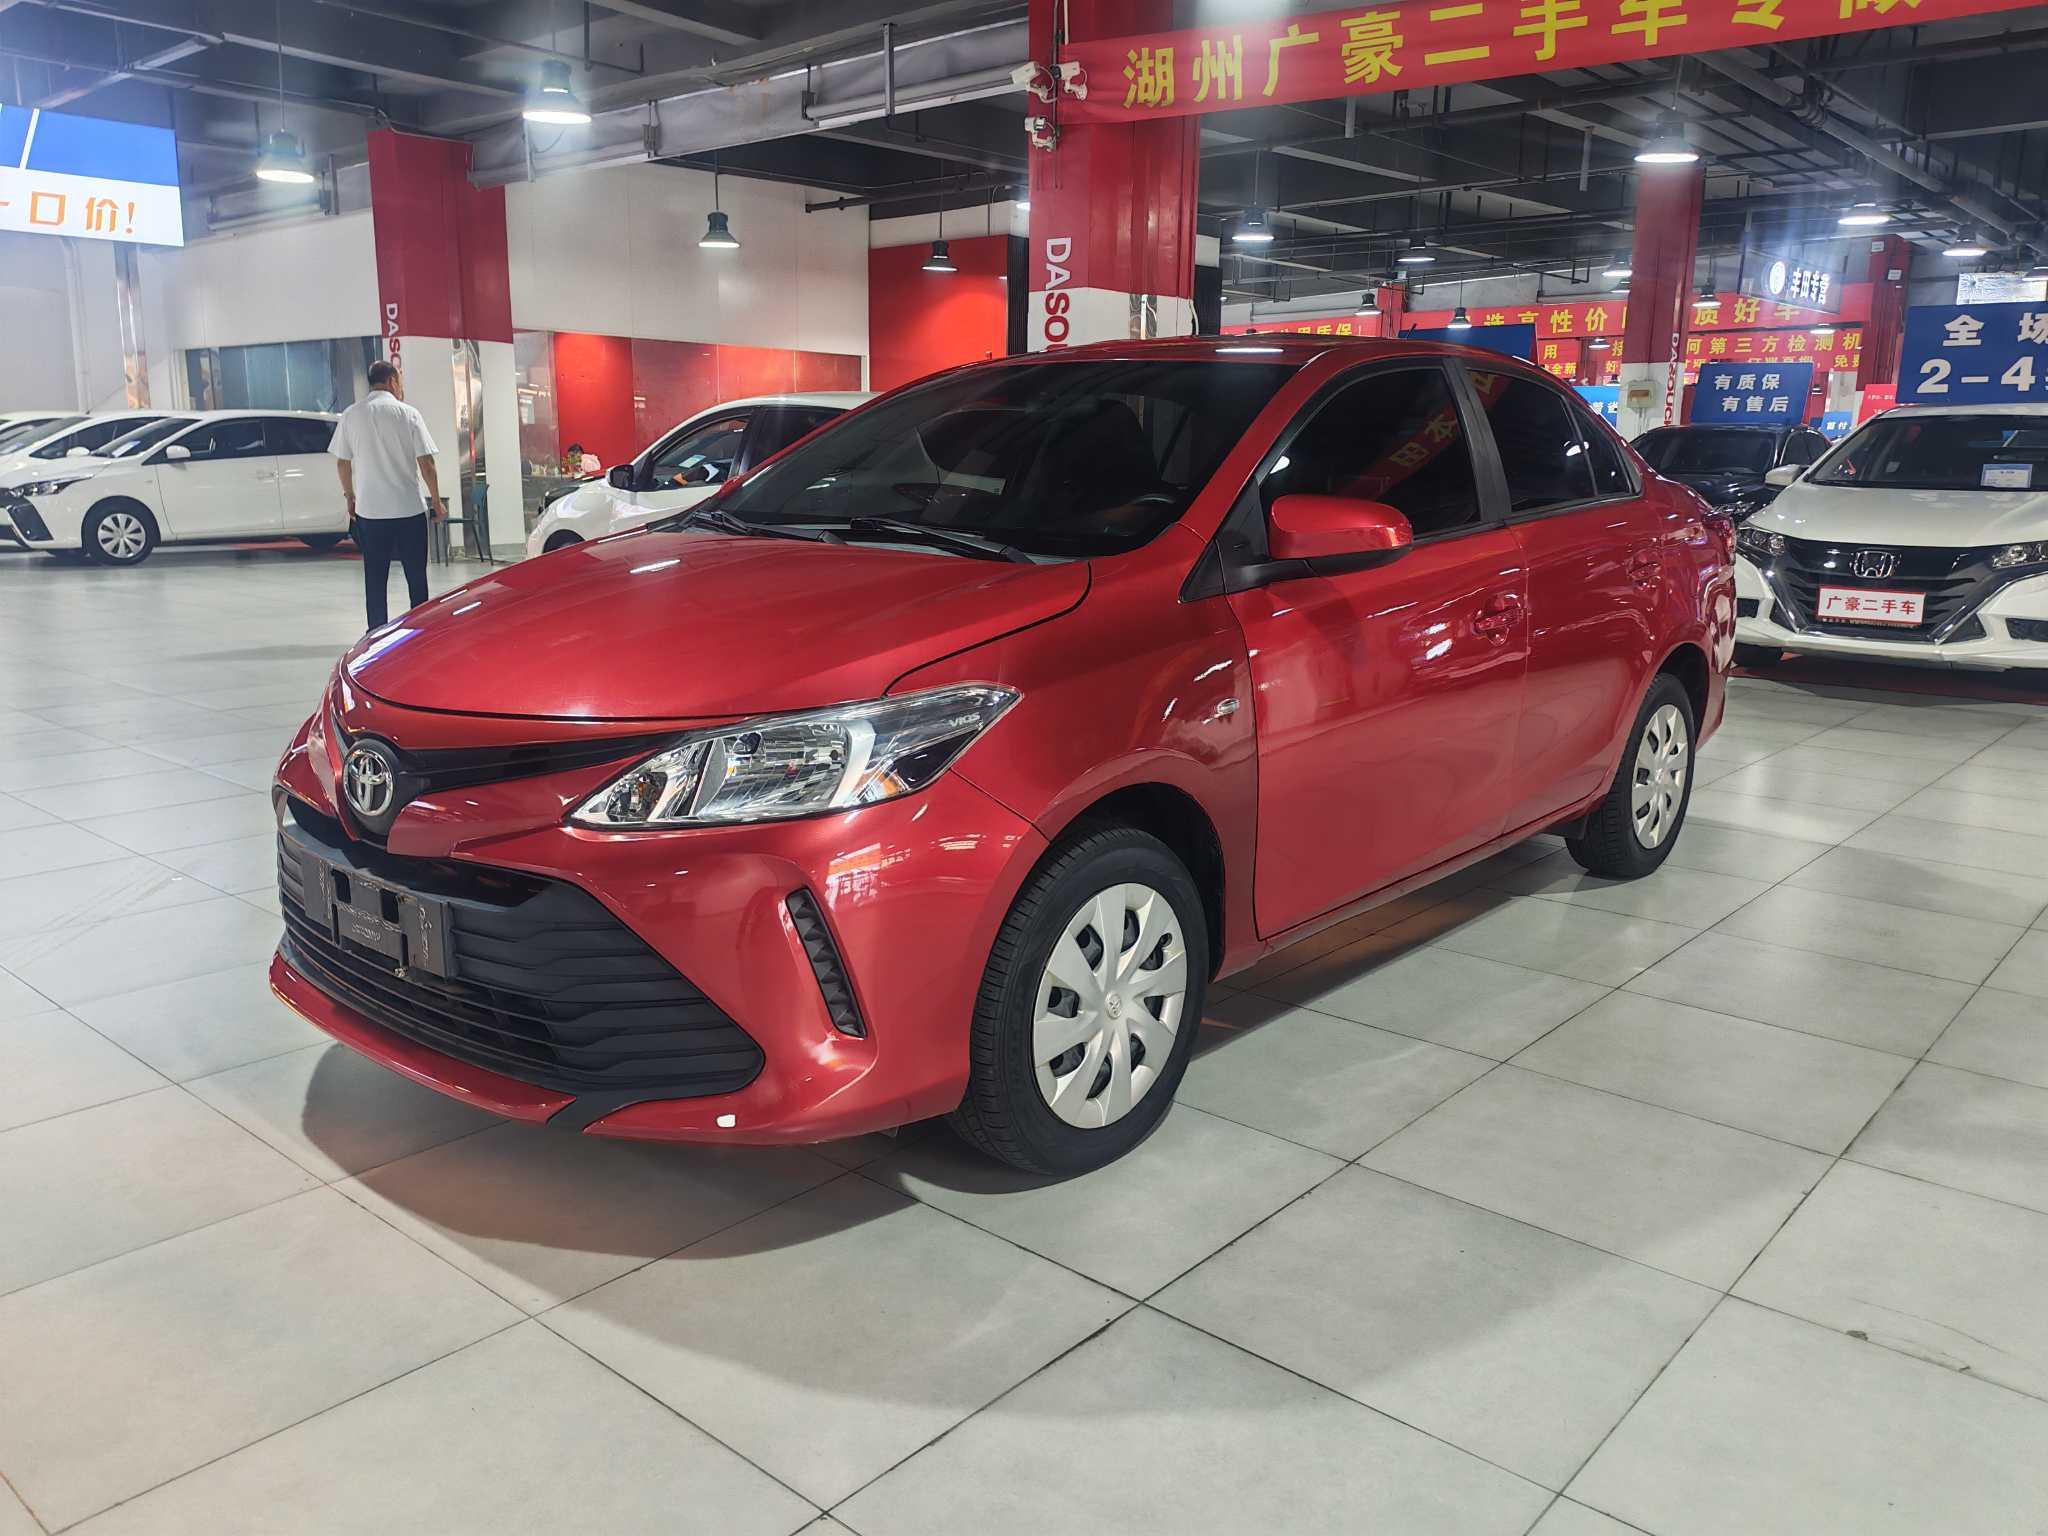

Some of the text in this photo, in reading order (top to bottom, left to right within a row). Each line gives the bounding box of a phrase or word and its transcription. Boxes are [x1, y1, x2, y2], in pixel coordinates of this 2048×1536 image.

[1122, 0, 1922, 109] 湖州广豪二手车
[1714, 372, 1781, 391] 有质保
[1916, 356, 2048, 394] 2-4
[1722, 395, 1790, 413] 有售后
[1826, 595, 1917, 616] 广豪二手车
